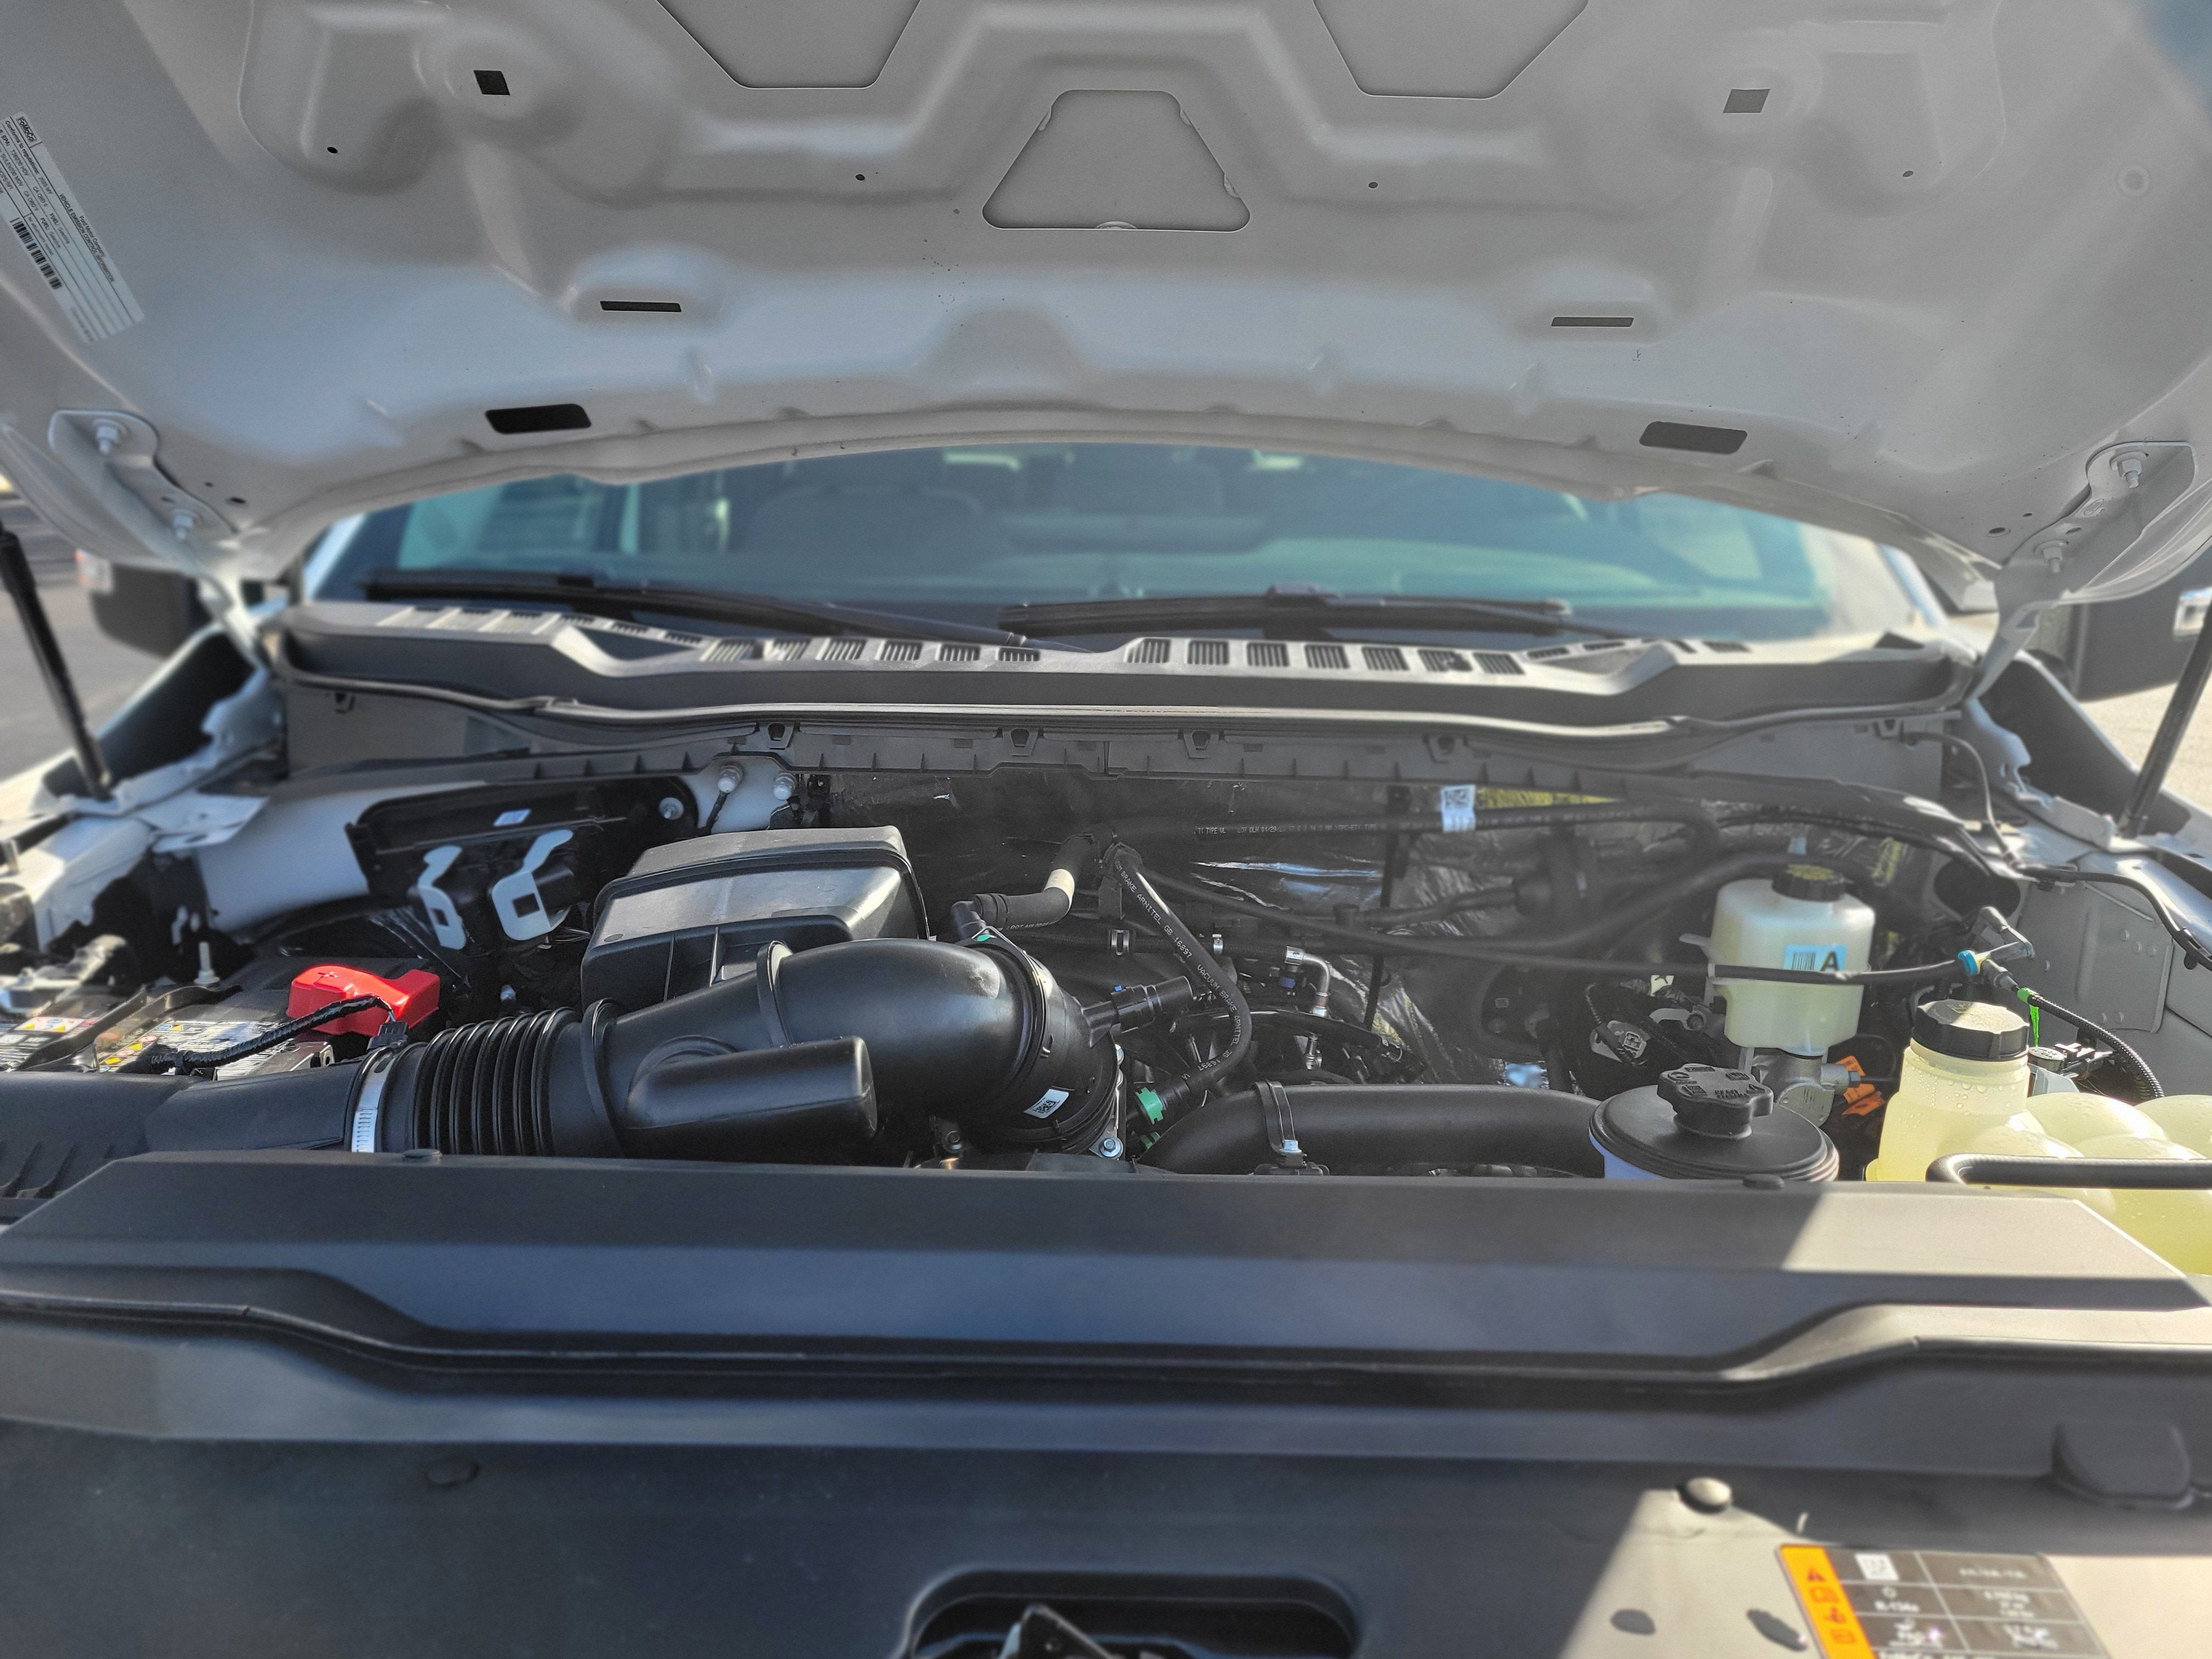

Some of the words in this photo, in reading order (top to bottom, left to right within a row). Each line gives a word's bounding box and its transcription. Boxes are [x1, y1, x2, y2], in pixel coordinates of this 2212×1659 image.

[18, 117, 36, 142] FoMoCo
[1, 134, 10, 146] EPA:
[49, 213, 59, 225] FUEL:
[40, 217, 49, 230] FUEL:
[60, 194, 72, 212] VEHICLE
[71, 213, 84, 233] EMISSION
[83, 234, 97, 253] CONTROL
[1121, 871, 1137, 893] BRAKE
[1137, 894, 1162, 924] ARNITEL
[1164, 925, 1173, 935] GB
[1174, 937, 1192, 958] 16897
[1197, 964, 1220, 991] VACUUM
[1219, 990, 1237, 1012] BRAKE
[1231, 1015, 1241, 1046] ARNITEL
[1820, 950, 1839, 971] A
